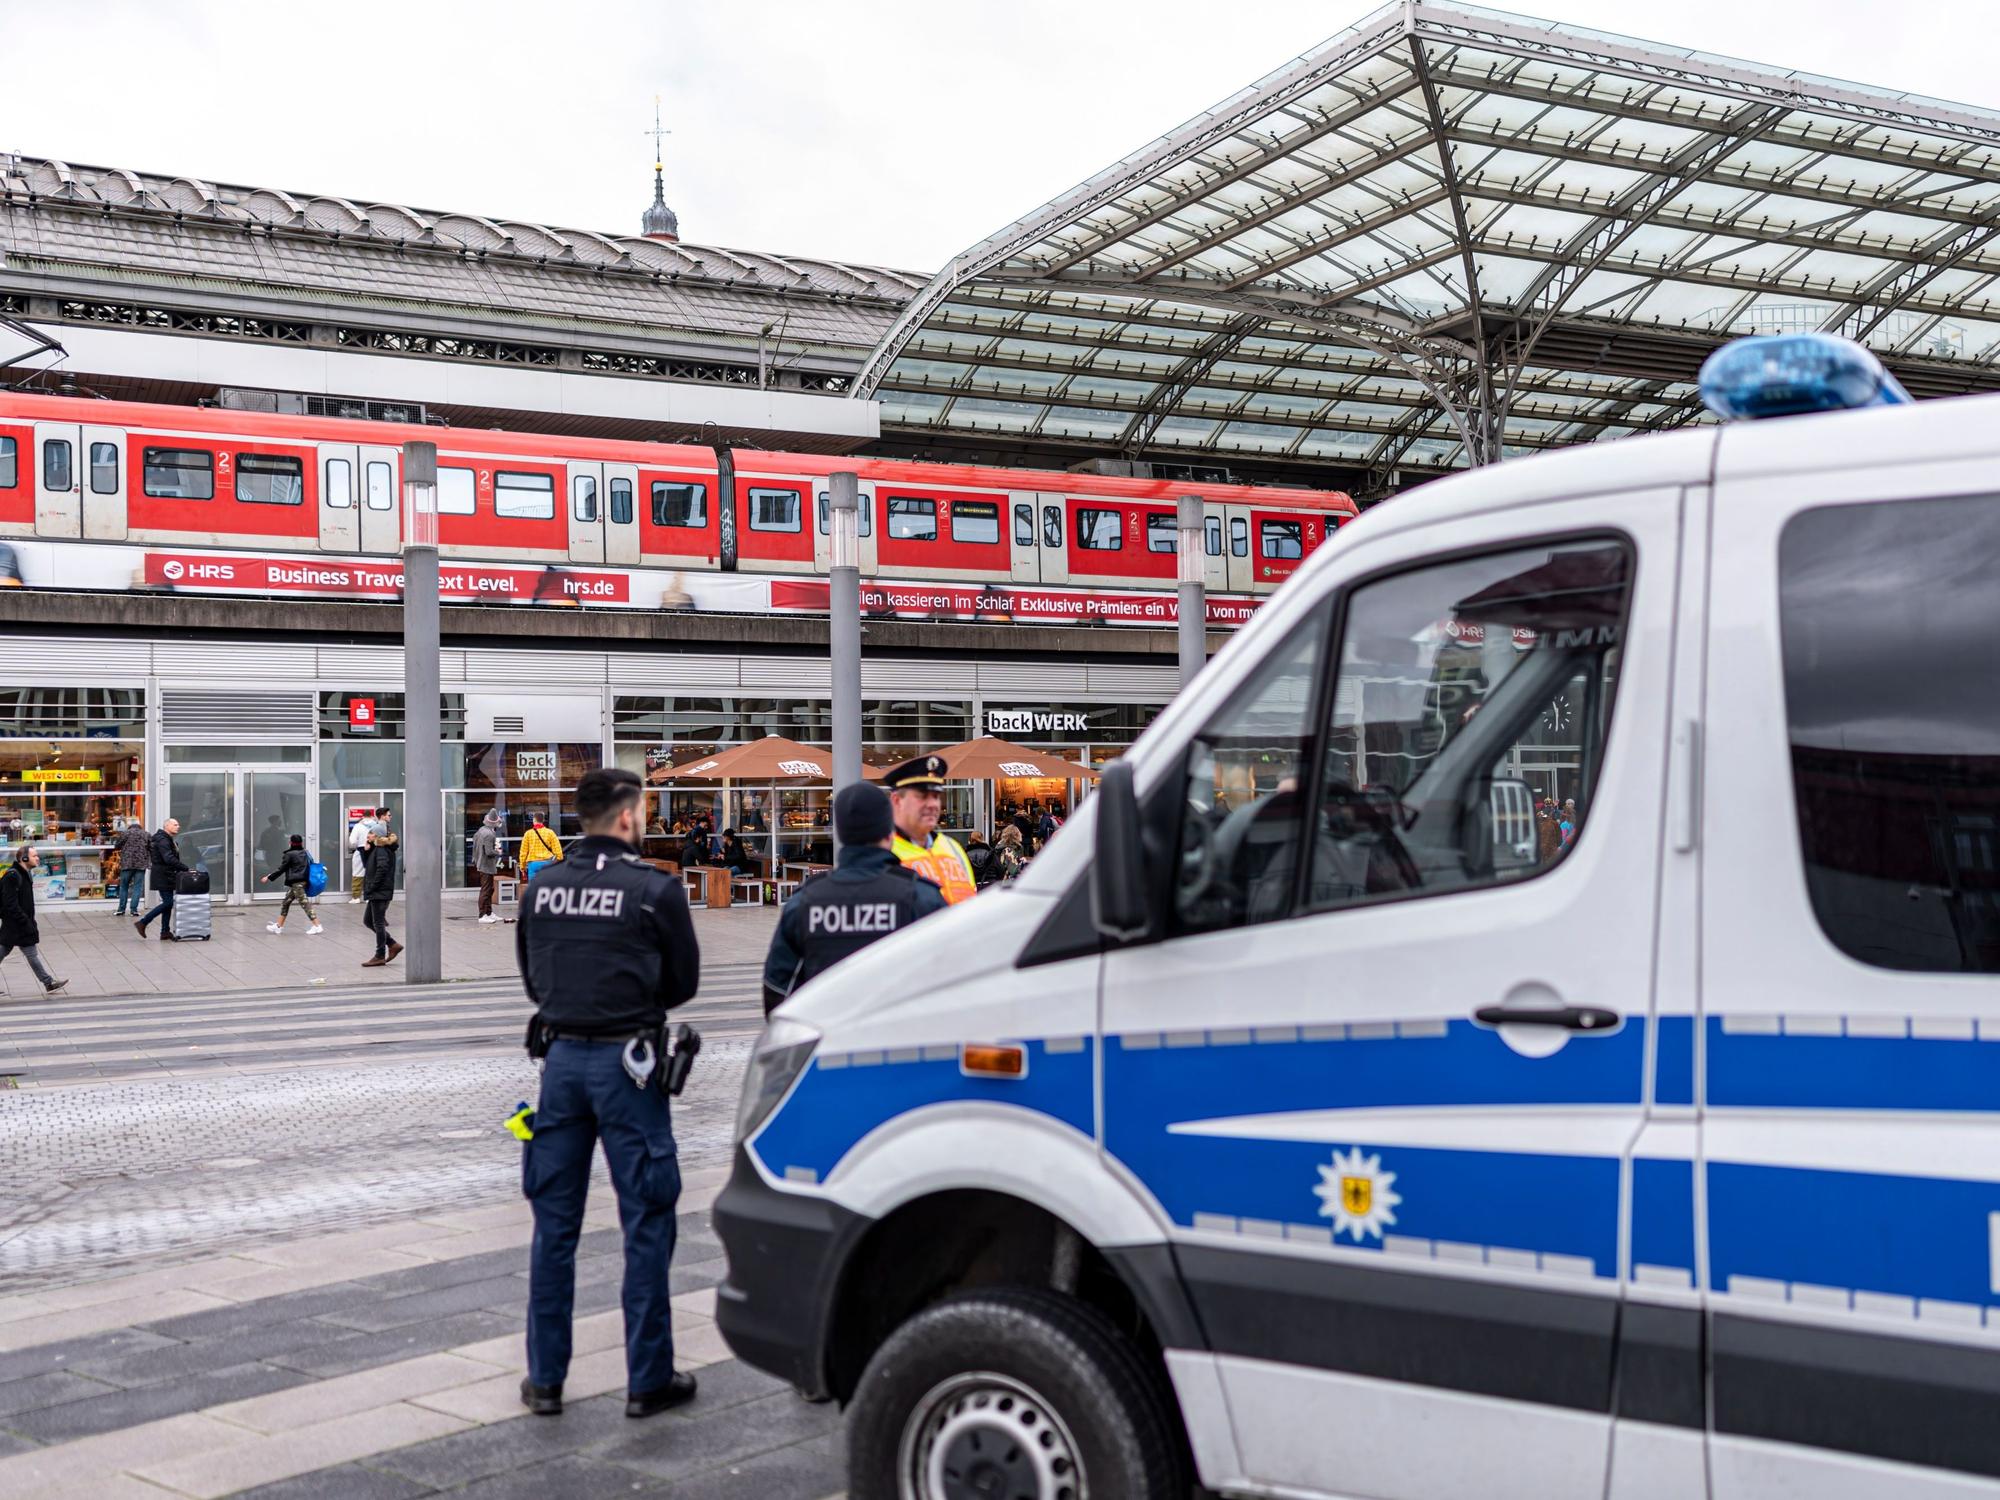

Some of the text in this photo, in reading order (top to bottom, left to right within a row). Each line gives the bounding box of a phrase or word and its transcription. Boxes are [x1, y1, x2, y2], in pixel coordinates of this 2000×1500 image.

[219, 452, 230, 467] 2
[480, 470, 490, 485] 2
[940, 500, 948, 513] 2
[1130, 512, 1138, 525] 2
[1307, 523, 1315, 535] 2
[189, 564, 234, 579] HRS
[268, 566, 519, 592] Business Trave ext Level.
[563, 578, 614, 596] hrs.de
[887, 592, 950, 608] kassieren
[955, 594, 971, 609] im
[976, 595, 1016, 611] Schlaf.
[1020, 597, 1083, 613] Exklusive
[1086, 599, 1142, 616] Prämien:
[1145, 602, 1164, 616] ein
[1213, 607, 1235, 619] von
[518, 753, 554, 767] back
[32, 772, 90, 780] WEST LOTTO
[517, 769, 556, 780] WERK
[535, 886, 624, 917] POLIZEI
[808, 903, 897, 933] POLIZEI
